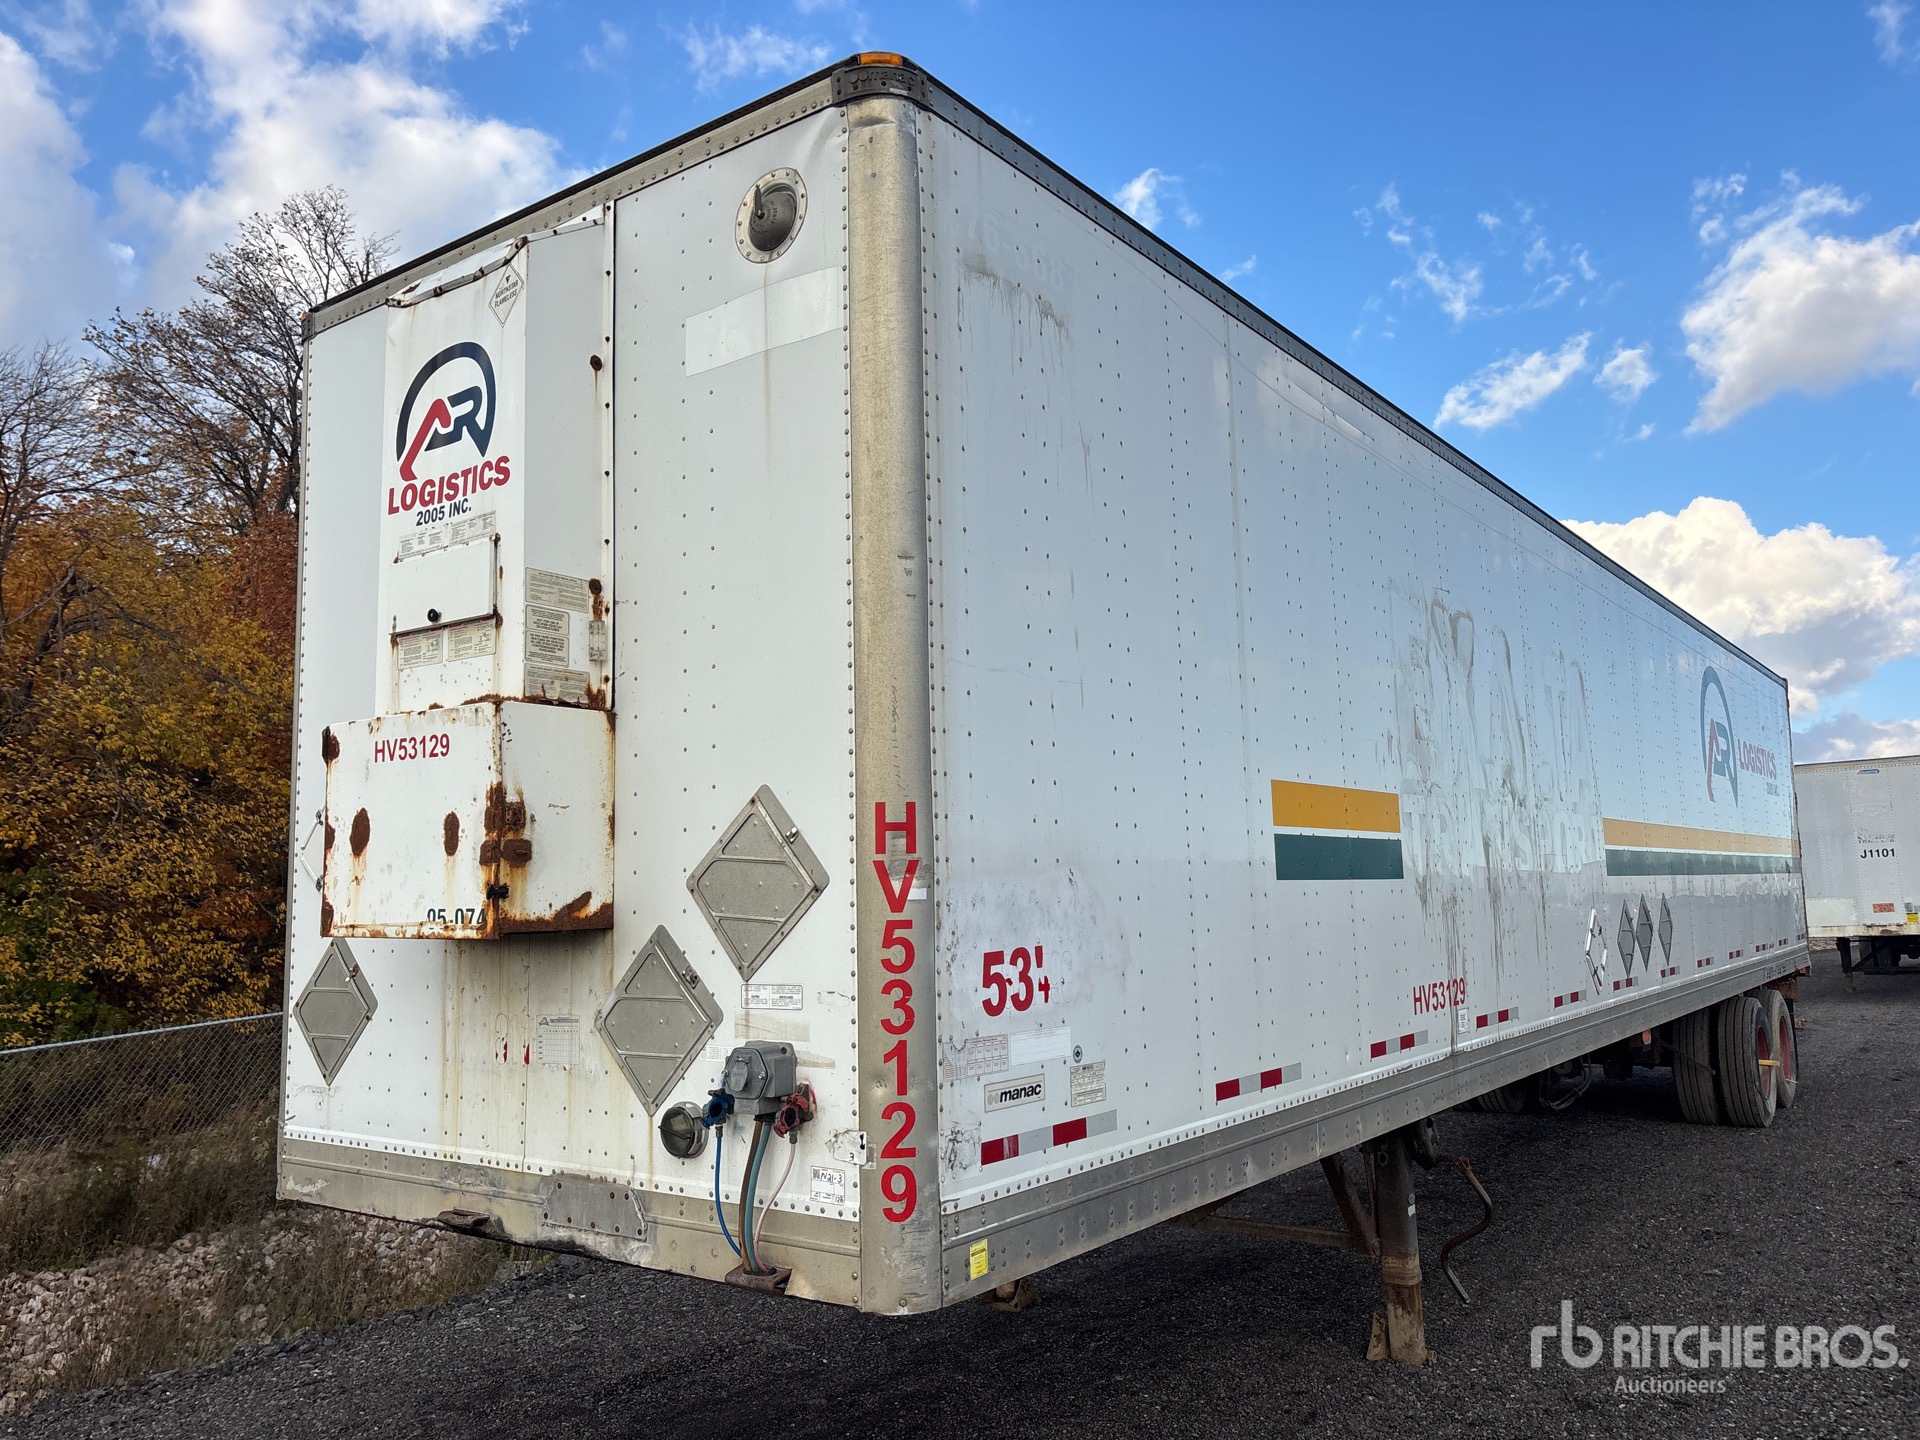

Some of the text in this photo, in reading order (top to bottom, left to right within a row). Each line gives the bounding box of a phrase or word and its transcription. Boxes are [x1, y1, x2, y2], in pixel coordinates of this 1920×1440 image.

[387, 455, 511, 515] LOGISTICS
[416, 498, 472, 526] 2005 INC.
[374, 733, 451, 763] HV53129
[1737, 738, 1777, 781] LOGISTICS
[1860, 848, 1895, 859] J1101
[1413, 977, 1466, 1015] HV53129
[999, 1083, 1042, 1103] manac
